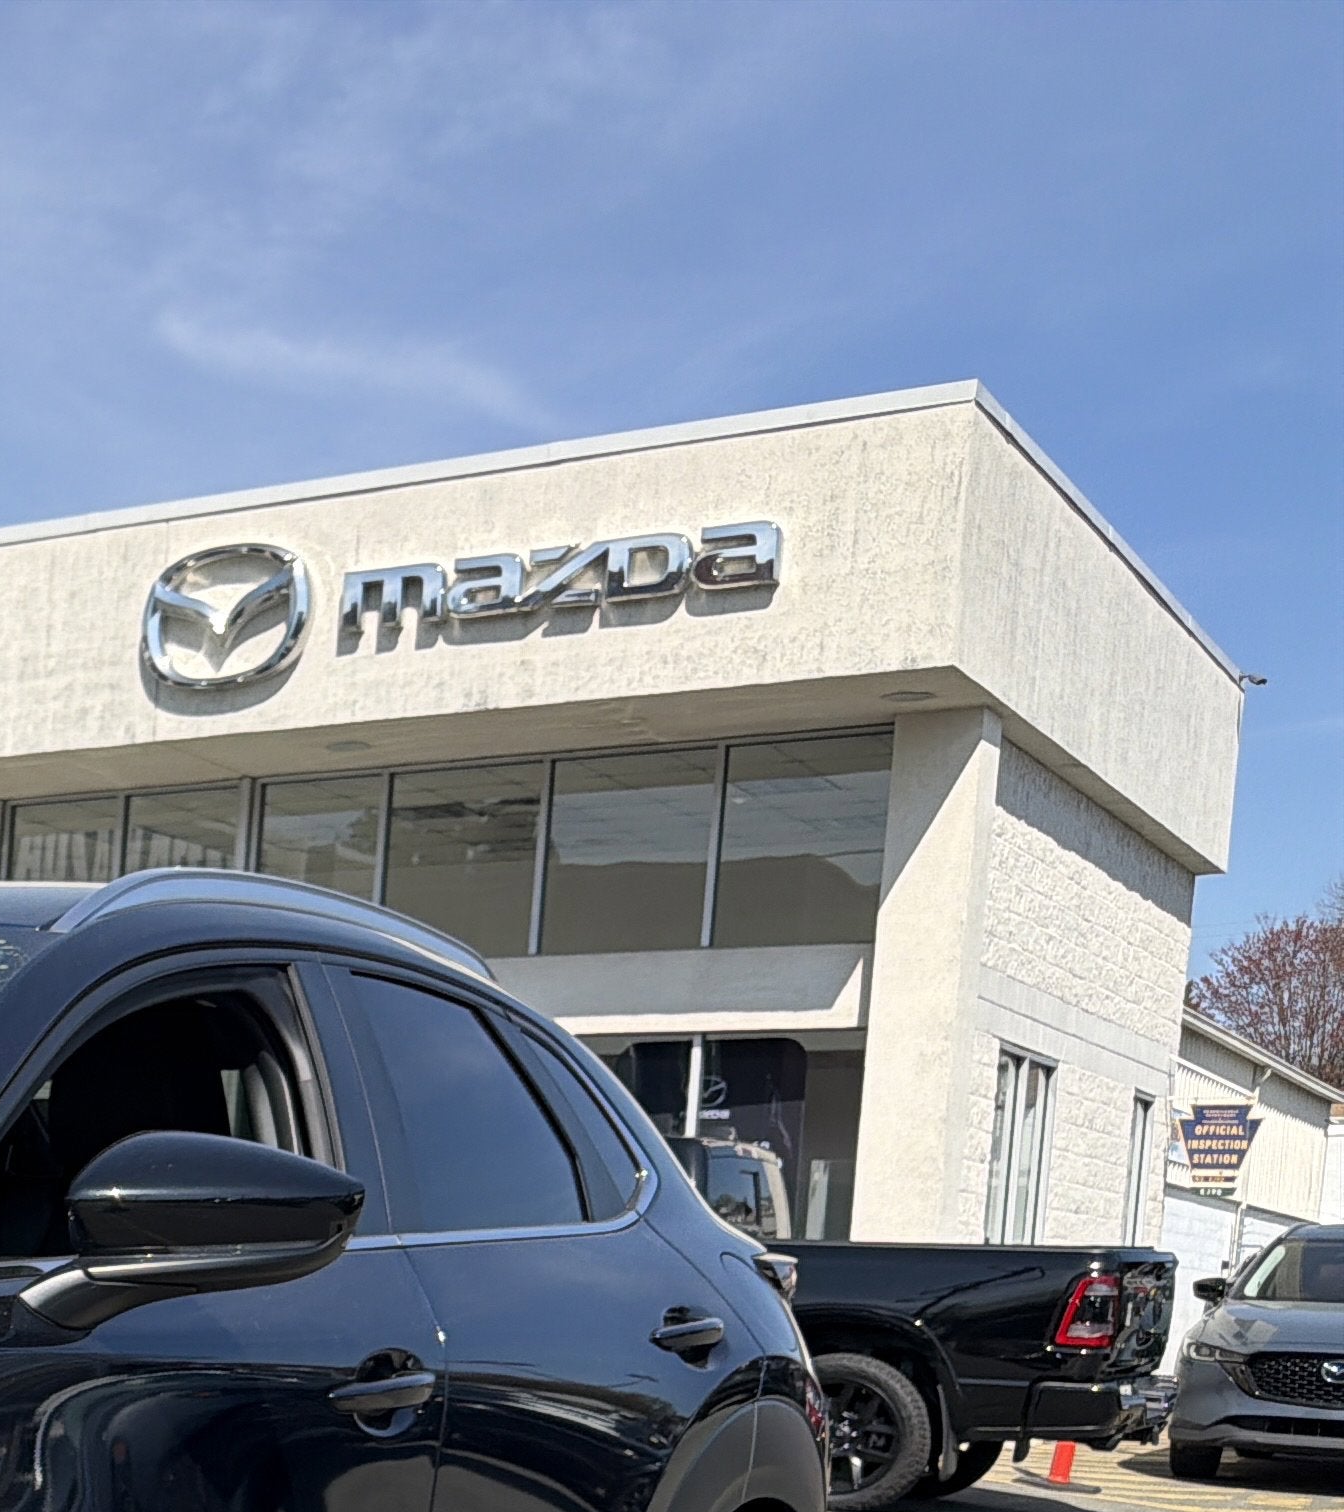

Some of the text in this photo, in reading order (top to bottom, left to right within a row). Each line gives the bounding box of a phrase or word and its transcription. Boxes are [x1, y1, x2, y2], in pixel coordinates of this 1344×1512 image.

[341, 520, 784, 632] mazda
[1194, 1124, 1245, 1136] OFFICIAL
[1187, 1138, 1249, 1150] INSPECTION
[1192, 1153, 1238, 1165] STATION
